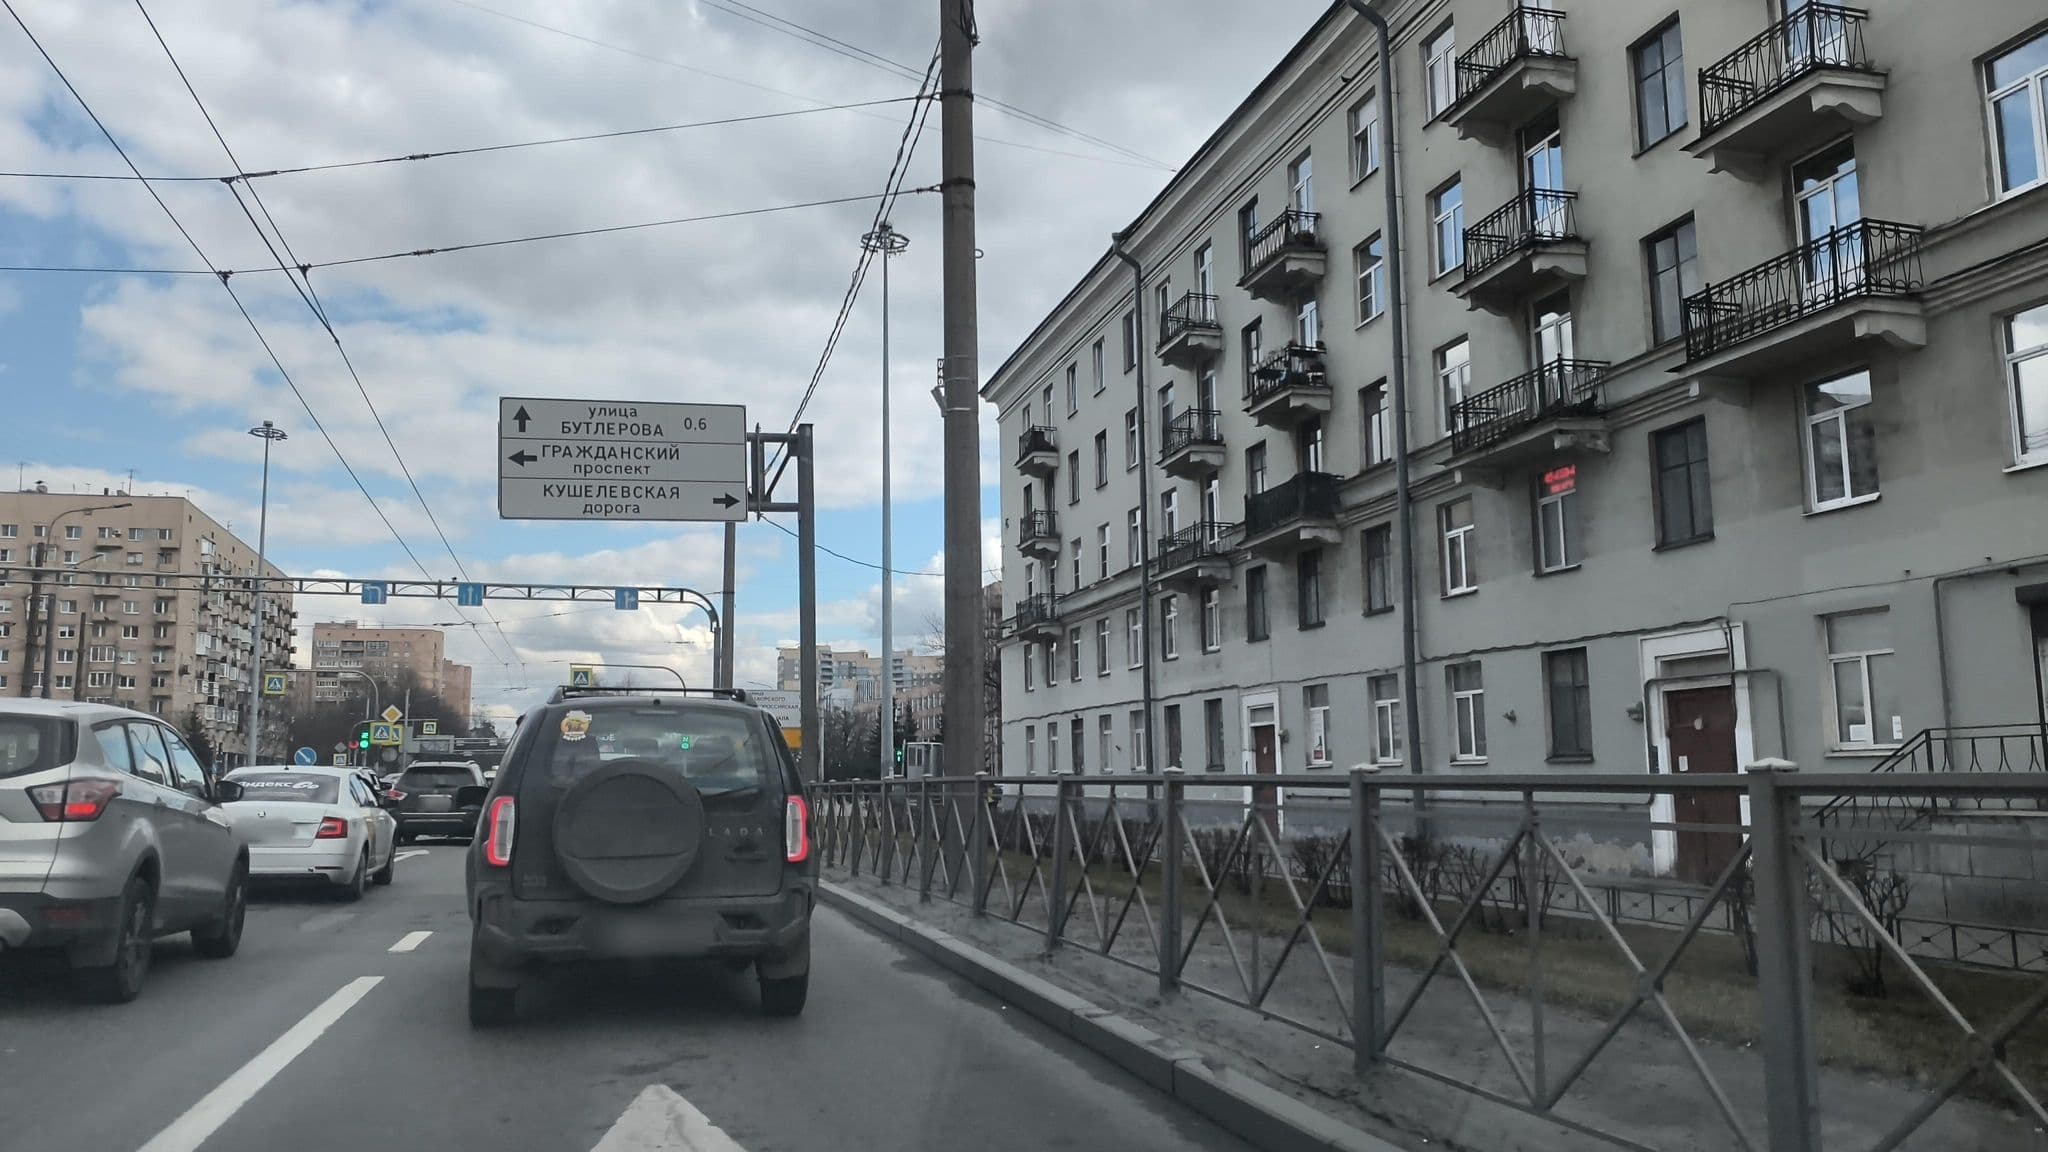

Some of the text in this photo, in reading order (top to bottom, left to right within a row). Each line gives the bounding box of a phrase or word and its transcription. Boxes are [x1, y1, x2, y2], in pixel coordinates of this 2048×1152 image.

[588, 406, 638, 419] улица
[561, 420, 664, 437] БУТЛЕРОВА
[683, 417, 708, 431] 0.6
[541, 443, 680, 461] ГРАЖДАНСКИЙ
[573, 463, 651, 477] проспект
[543, 484, 680, 499] КУШЕЛЕВСКАЯ
[582, 503, 641, 516] дорога
